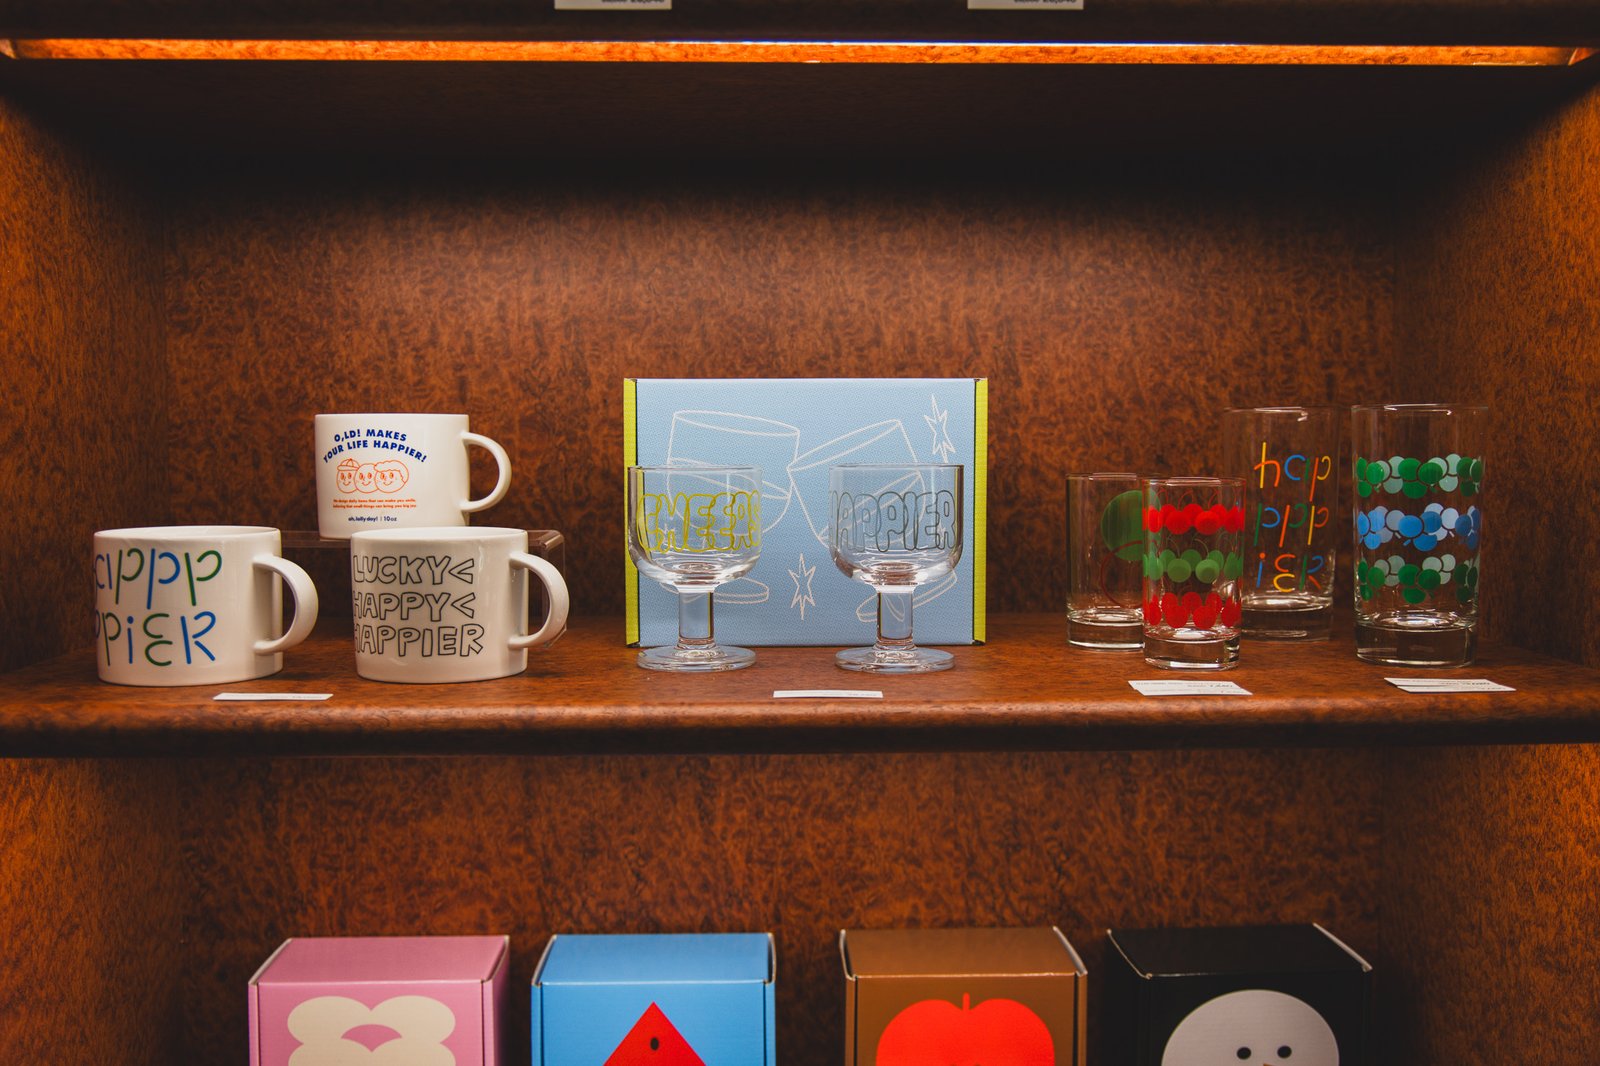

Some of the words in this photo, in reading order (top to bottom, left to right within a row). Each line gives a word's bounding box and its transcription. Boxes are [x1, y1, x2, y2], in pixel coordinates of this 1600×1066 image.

[334, 429, 361, 442] O,LD!
[366, 429, 407, 442] MAKES
[323, 444, 344, 463] YOUR
[347, 440, 368, 450] LIFE
[373, 440, 427, 463] HAPPIER!
